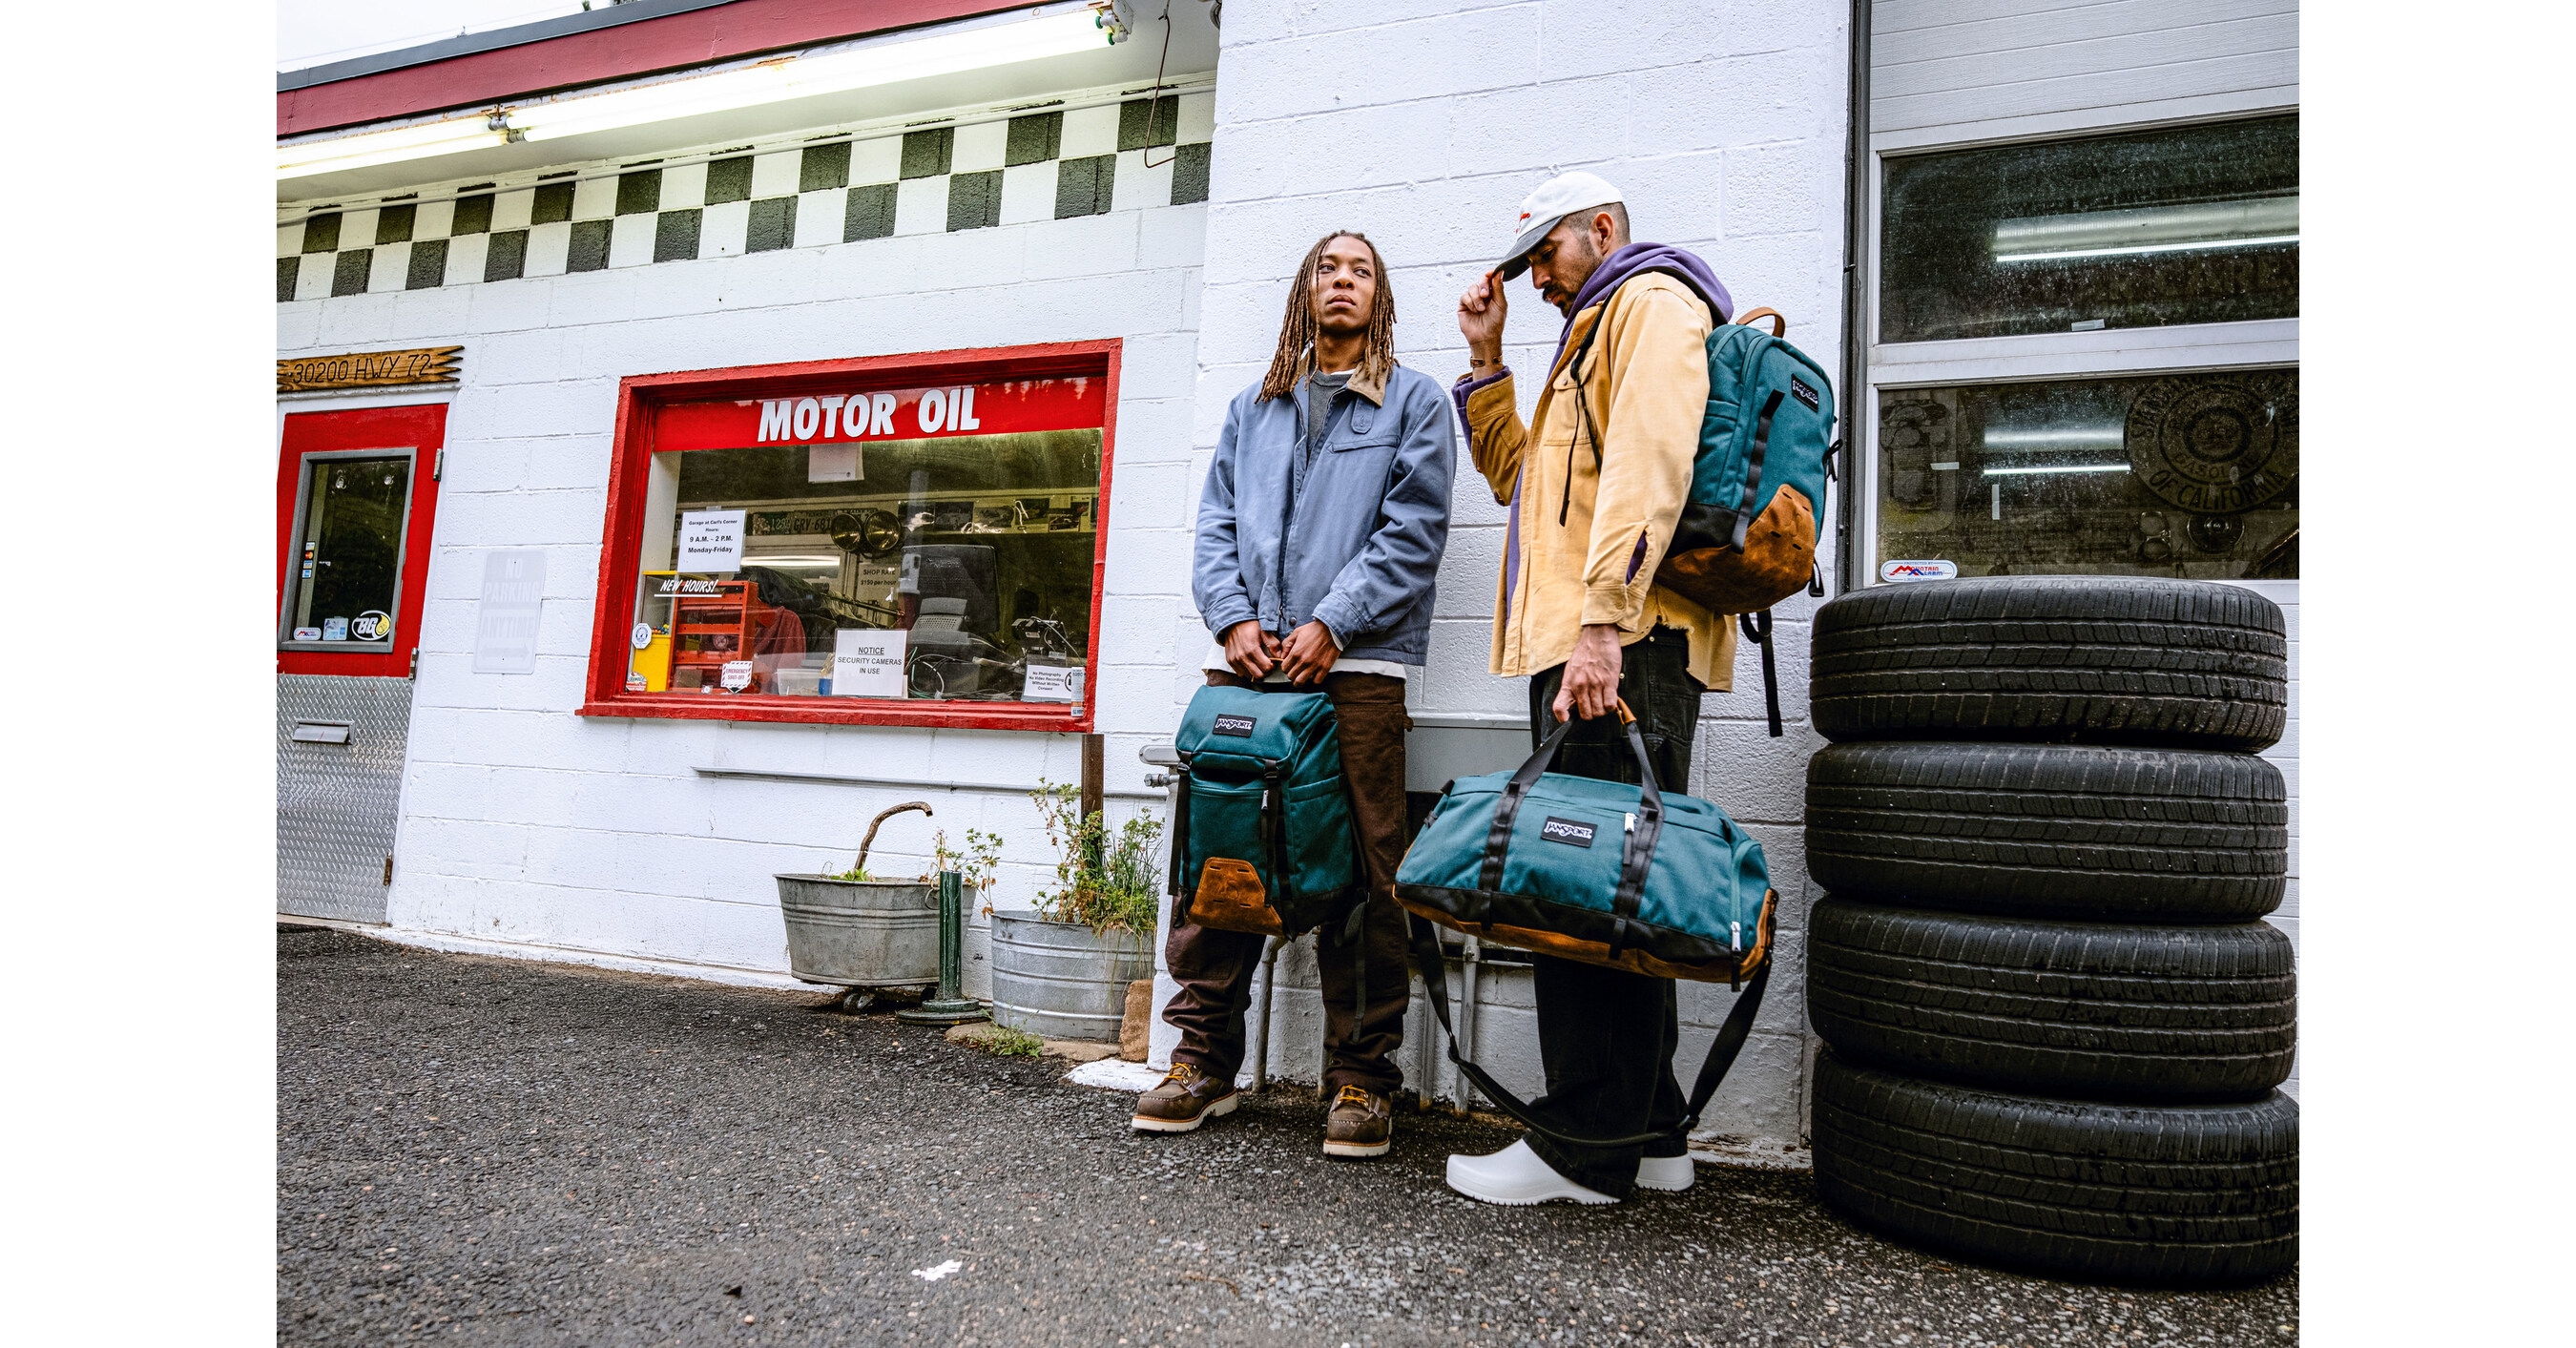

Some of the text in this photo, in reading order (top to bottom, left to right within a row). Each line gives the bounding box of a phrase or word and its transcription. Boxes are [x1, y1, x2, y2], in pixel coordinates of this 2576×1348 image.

[293, 360, 349, 384] 30200
[406, 354, 431, 377] 72
[758, 387, 981, 443] MOTOR OIL
[2173, 452, 2261, 477] GASOLNE
[2149, 468, 2290, 510] OF CALIFORNIA
[506, 558, 523, 579] NO
[484, 581, 540, 603] PARKING
[660, 579, 718, 592] NEW HOURS!
[481, 616, 535, 638] ANYTIME
[1215, 718, 1252, 730] JANSPORT
[1544, 821, 1592, 839] JANSPORT
